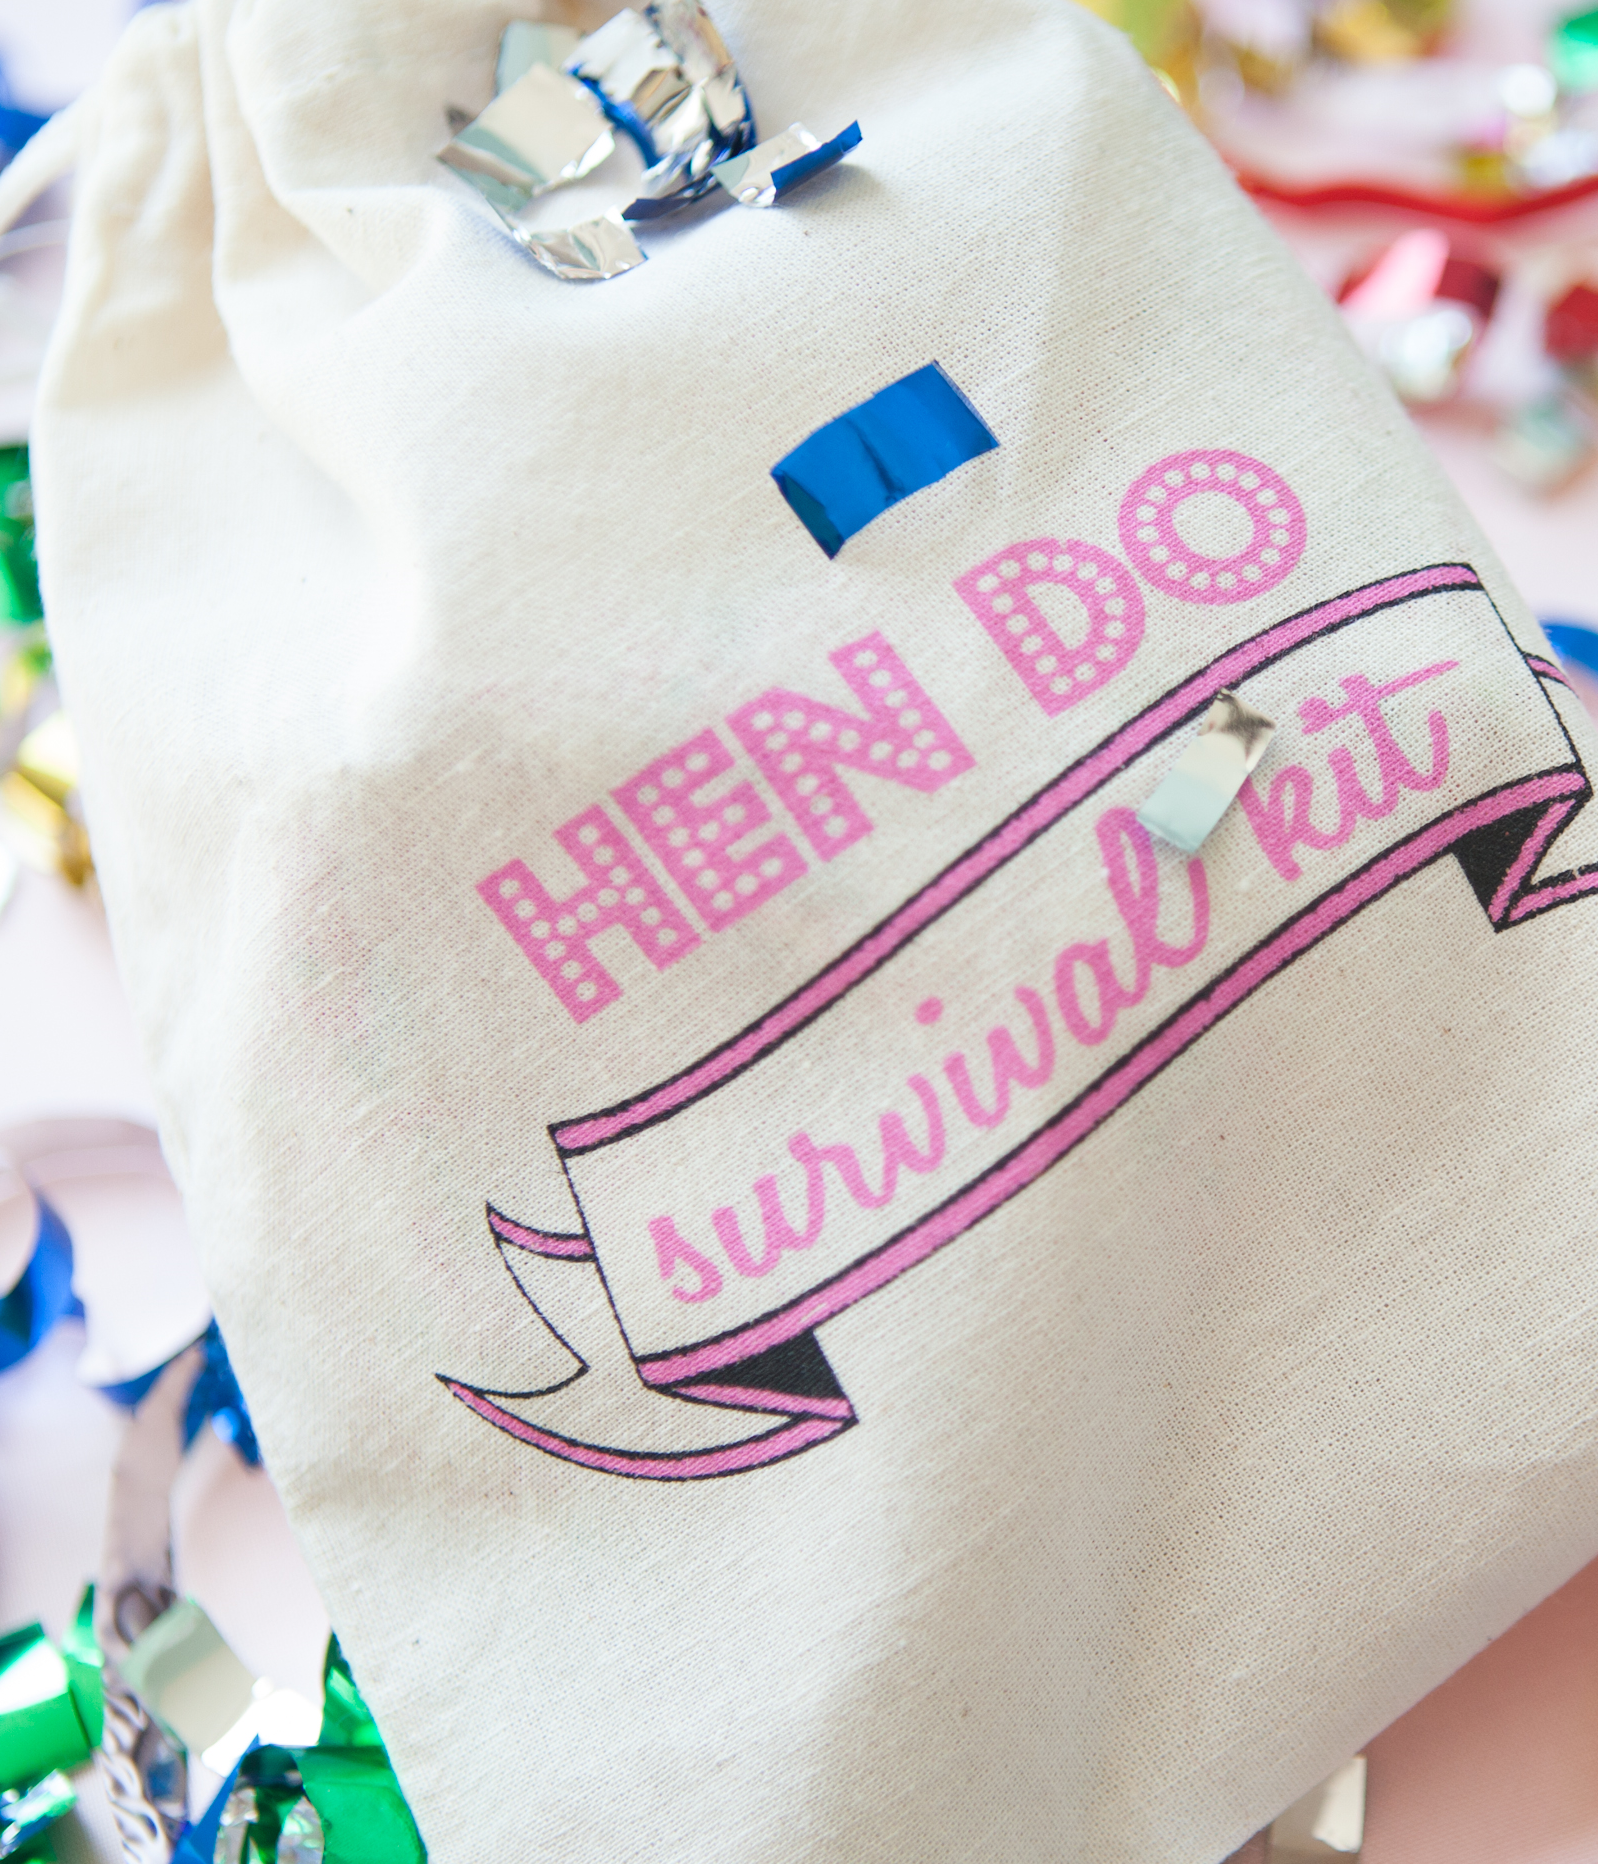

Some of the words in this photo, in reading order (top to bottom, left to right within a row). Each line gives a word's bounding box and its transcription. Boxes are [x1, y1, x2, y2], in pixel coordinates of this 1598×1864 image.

[476, 630, 977, 1024] HEN
[952, 448, 1308, 718] DO
[646, 806, 1211, 1304] survival
[1237, 659, 1460, 881] kit
